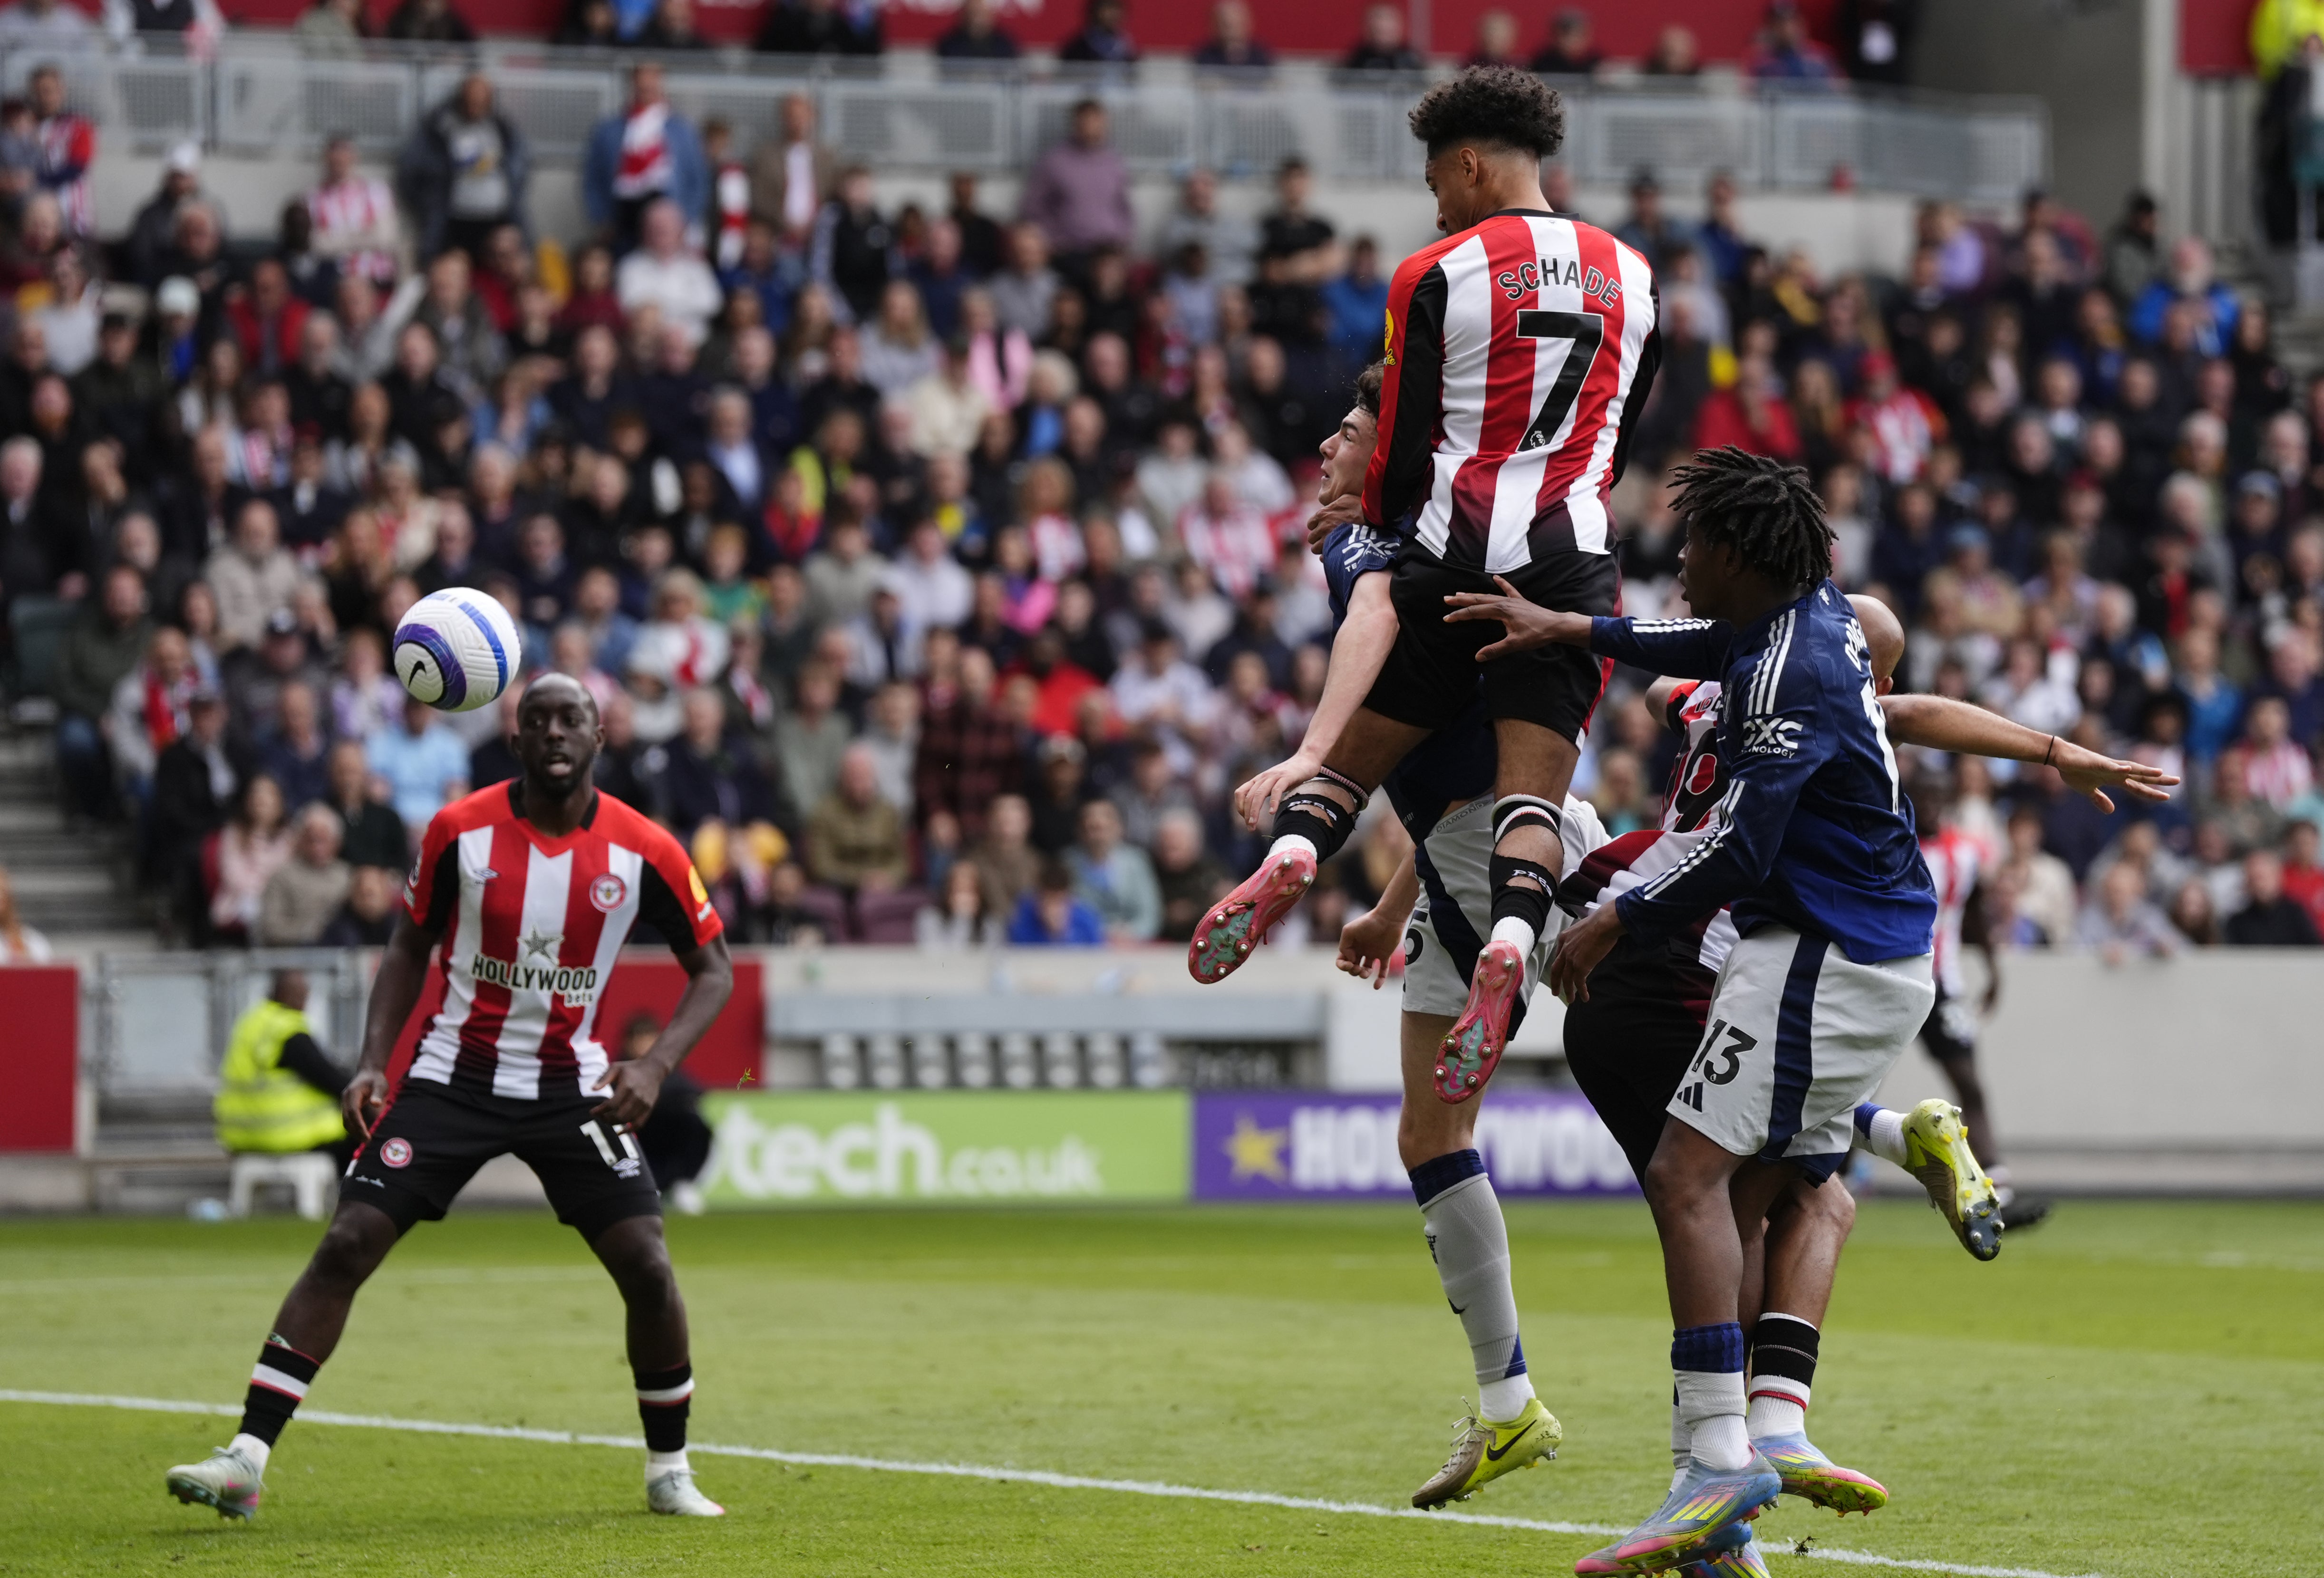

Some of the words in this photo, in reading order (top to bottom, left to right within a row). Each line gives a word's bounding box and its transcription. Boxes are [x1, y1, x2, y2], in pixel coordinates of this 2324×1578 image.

[1498, 258, 1622, 309] SCHADE
[1516, 309, 1603, 453] 7
[1342, 539, 1400, 566] DXC
[1741, 745, 1795, 759] NOLOGY
[1436, 802, 1484, 833] DIAMOND
[472, 953, 597, 991] HOLLYWOOD
[1691, 1018, 1759, 1086] 13
